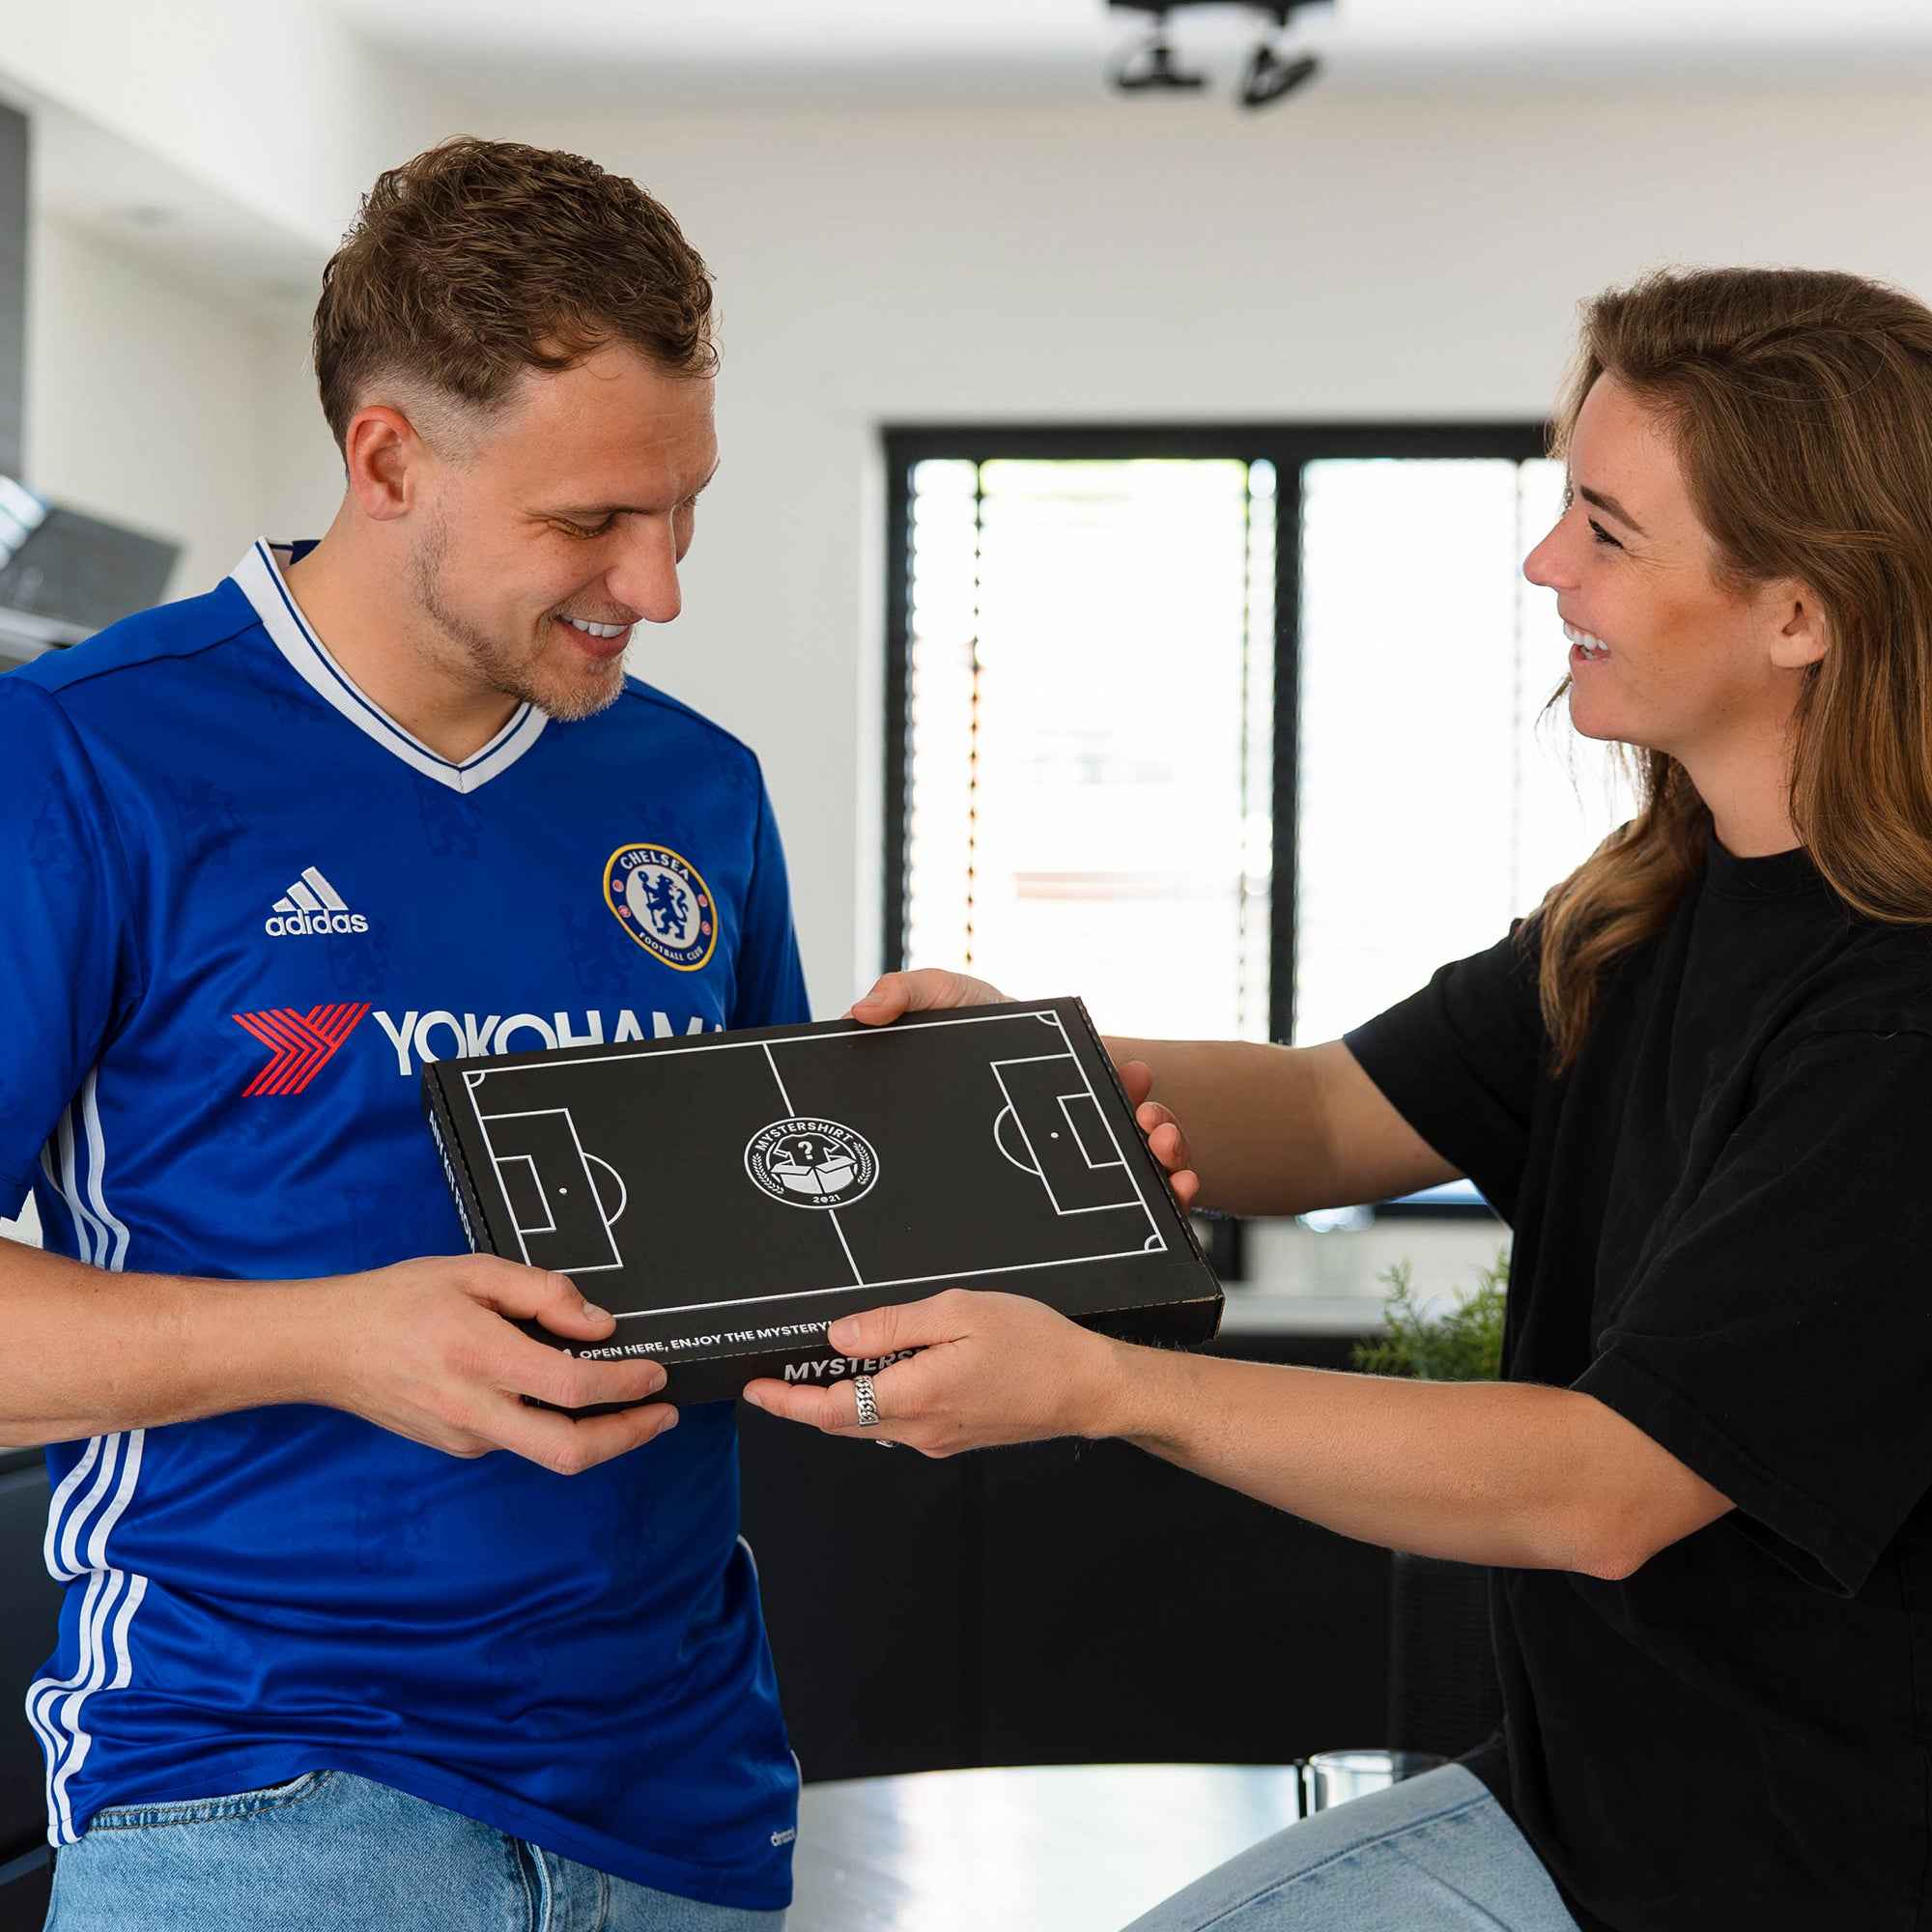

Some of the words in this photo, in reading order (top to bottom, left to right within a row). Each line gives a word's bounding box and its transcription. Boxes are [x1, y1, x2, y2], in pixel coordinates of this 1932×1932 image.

[620, 850, 689, 880] CHELSEA
[265, 908, 369, 936] adidas
[639, 932, 684, 961] FOOTBALL
[686, 946, 704, 960] CLUB
[372, 1009, 724, 1076] YOKOH
[754, 1122, 854, 1151] MYSTERSHIRT
[812, 1193, 841, 1204] 2021
[579, 1347, 623, 1359] OPEN
[624, 1341, 669, 1354] HERE,
[670, 1334, 722, 1350] ENJOY
[724, 1330, 756, 1342] THE
